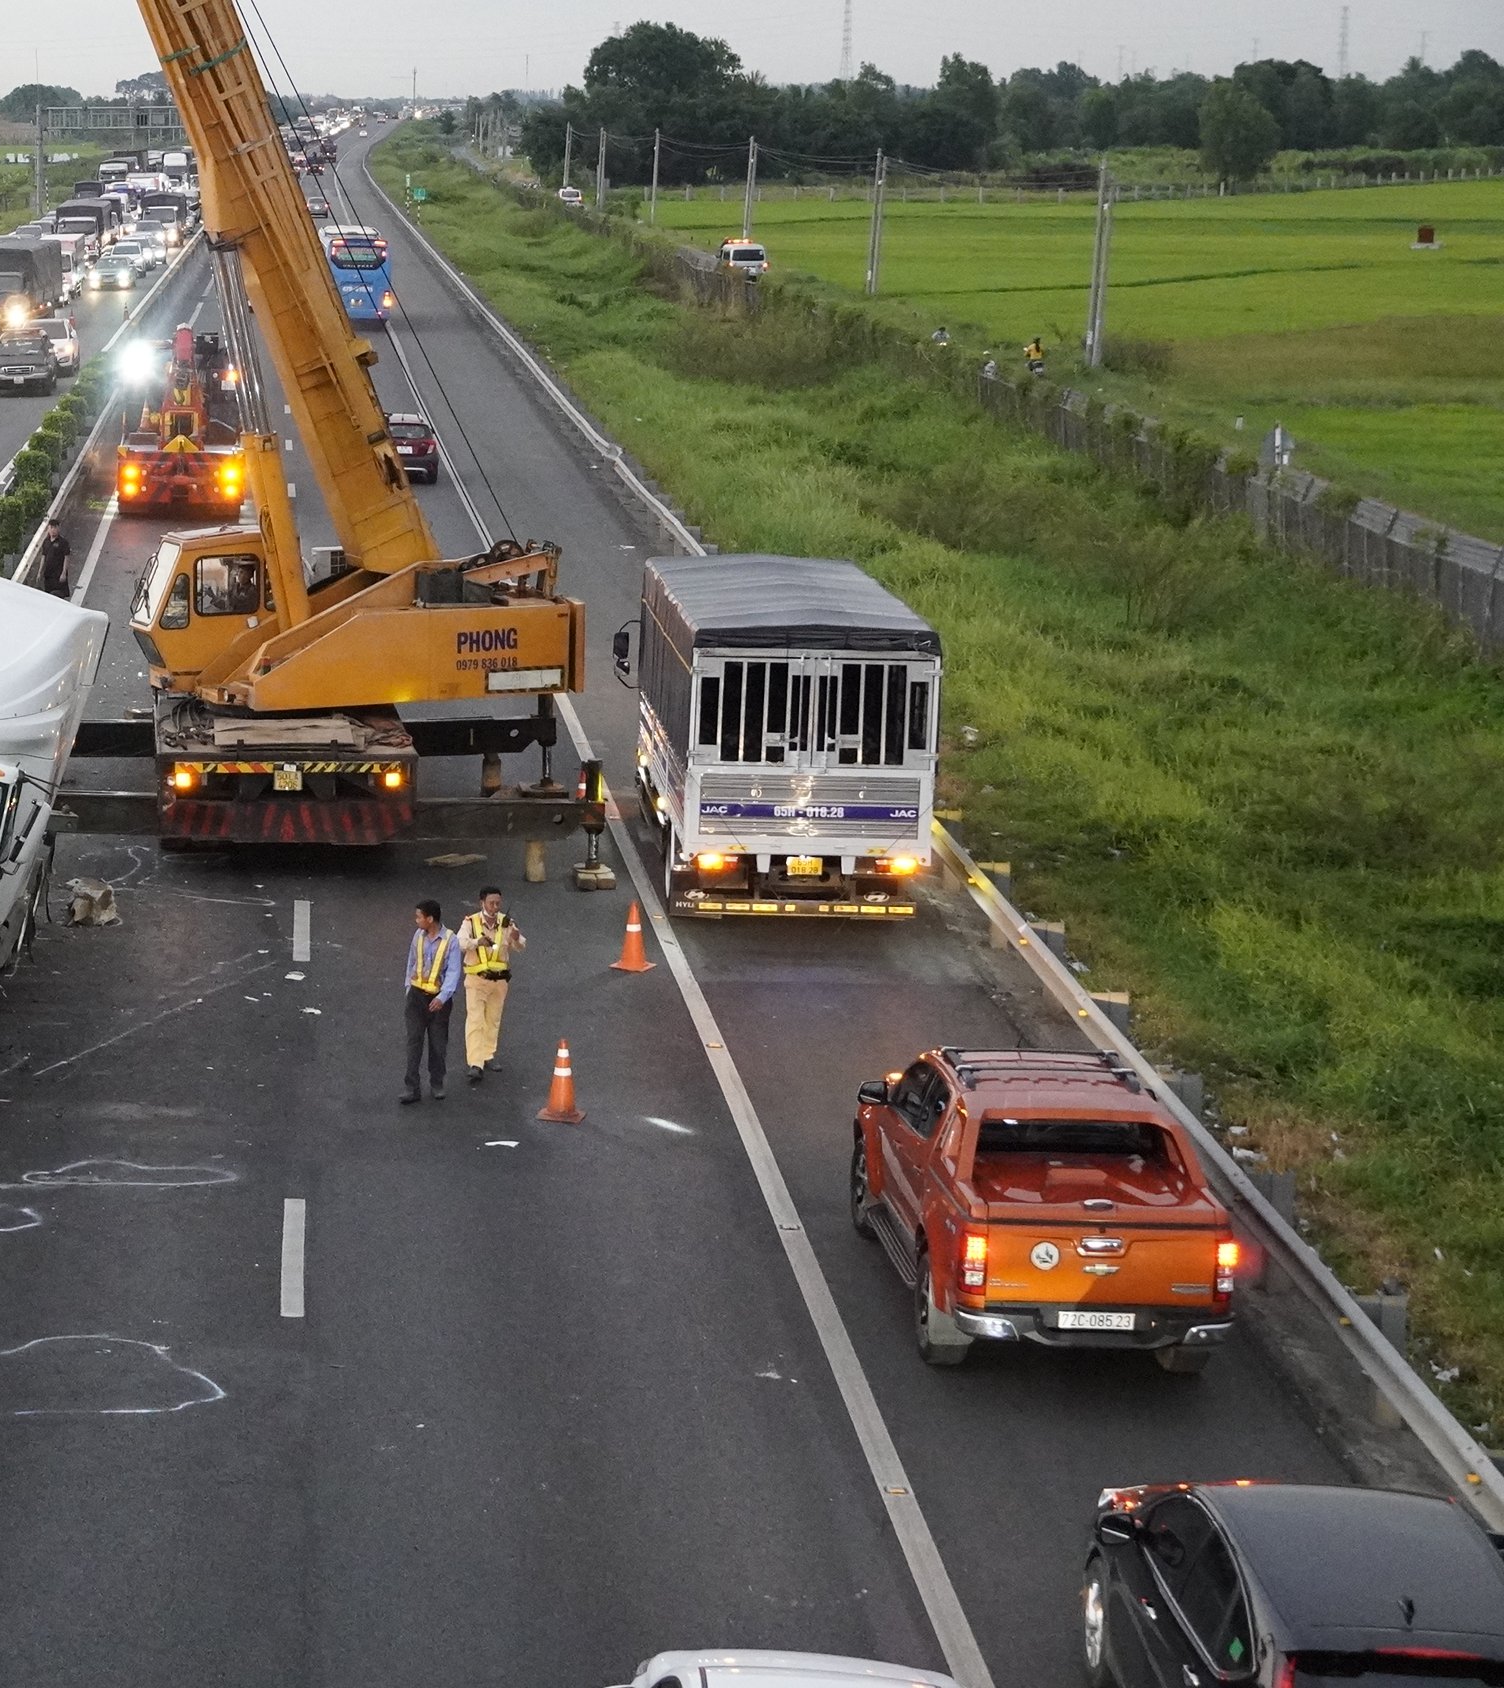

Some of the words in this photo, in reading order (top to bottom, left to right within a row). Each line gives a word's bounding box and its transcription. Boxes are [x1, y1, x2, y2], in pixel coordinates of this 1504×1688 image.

[456, 627, 518, 654] PHONG
[456, 659, 479, 671] 0979
[481, 658, 498, 669] 836
[501, 656, 518, 667] 018
[701, 805, 728, 814] JAC
[773, 806, 796, 817] 65H
[806, 806, 845, 818] 018.28
[889, 809, 917, 818] JAC
